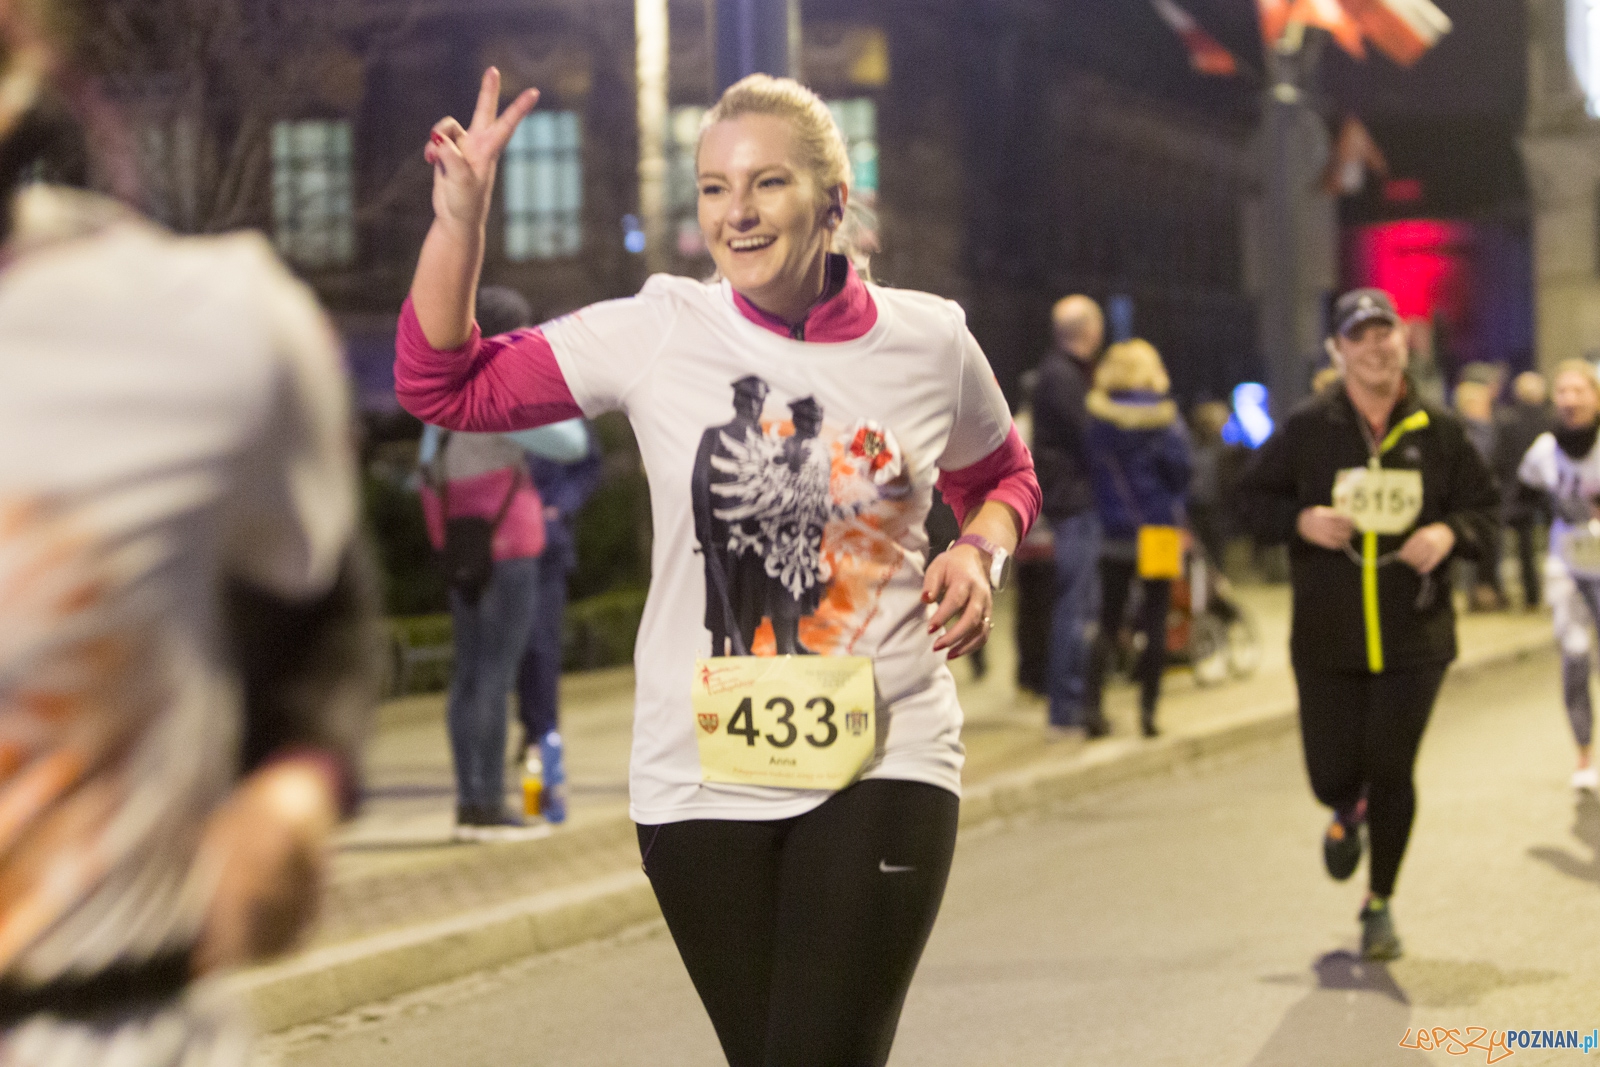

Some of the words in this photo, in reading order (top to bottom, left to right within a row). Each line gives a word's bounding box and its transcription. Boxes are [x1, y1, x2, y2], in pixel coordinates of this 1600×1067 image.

[1351, 486, 1406, 516] 515
[726, 696, 838, 749] 433
[768, 755, 797, 767] Anna
